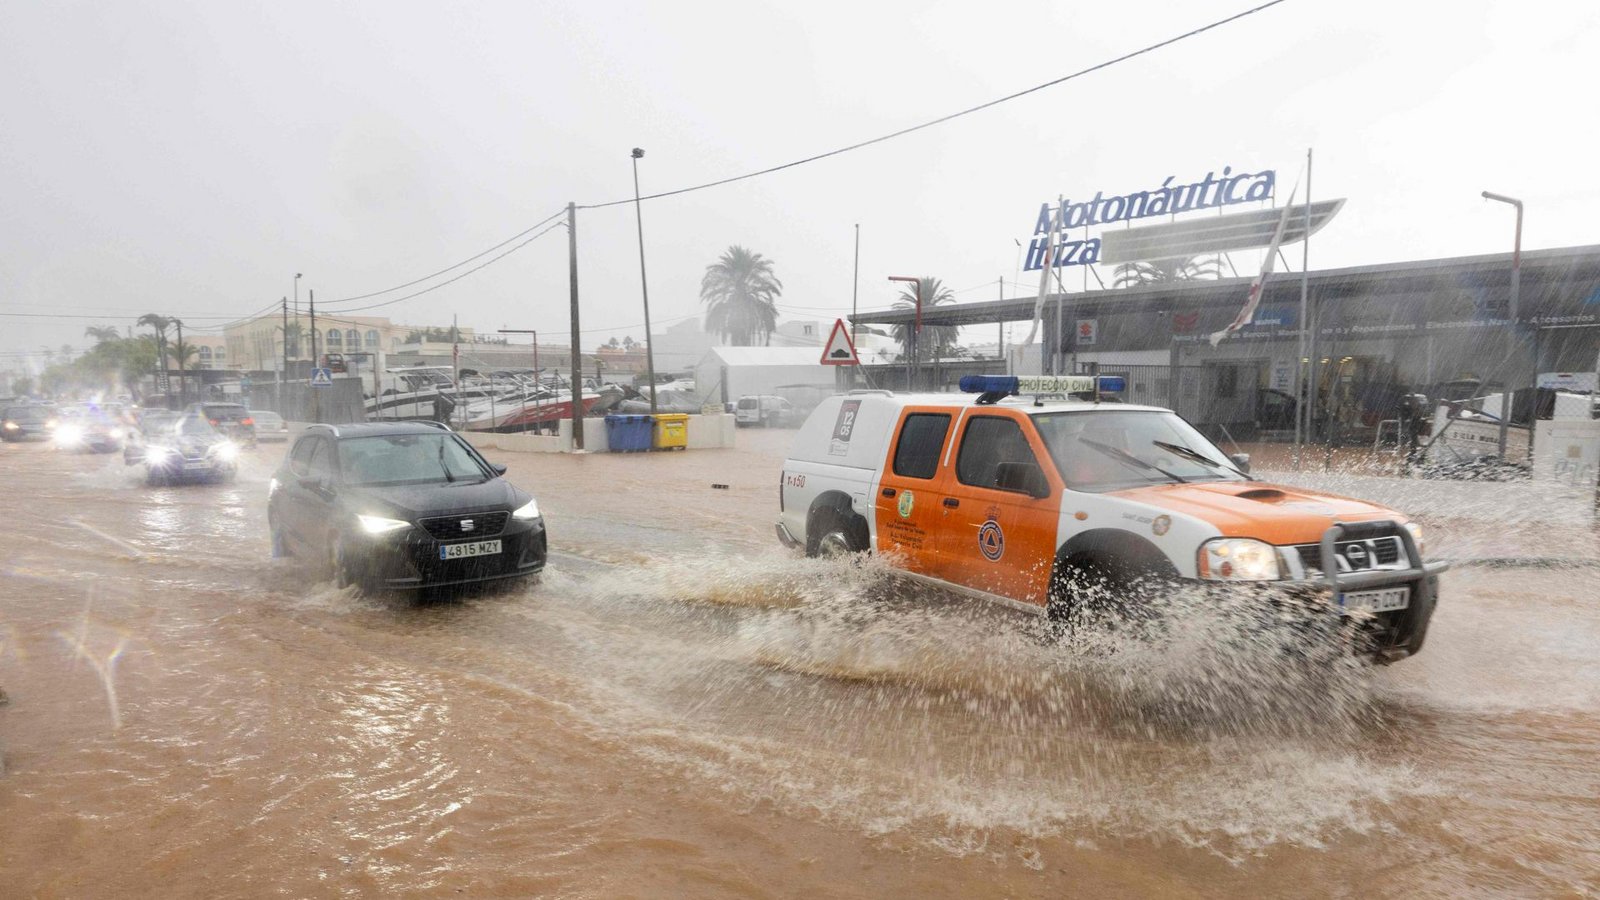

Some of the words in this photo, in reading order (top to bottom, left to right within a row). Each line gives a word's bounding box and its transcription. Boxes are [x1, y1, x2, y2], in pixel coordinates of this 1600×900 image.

[1034, 166, 1276, 235] Motonáutica
[1023, 233, 1101, 271] Ibiza
[1071, 379, 1094, 391] CIVIL
[843, 411, 854, 425] 12
[448, 544, 476, 557] 4815
[479, 541, 499, 554] MZY
